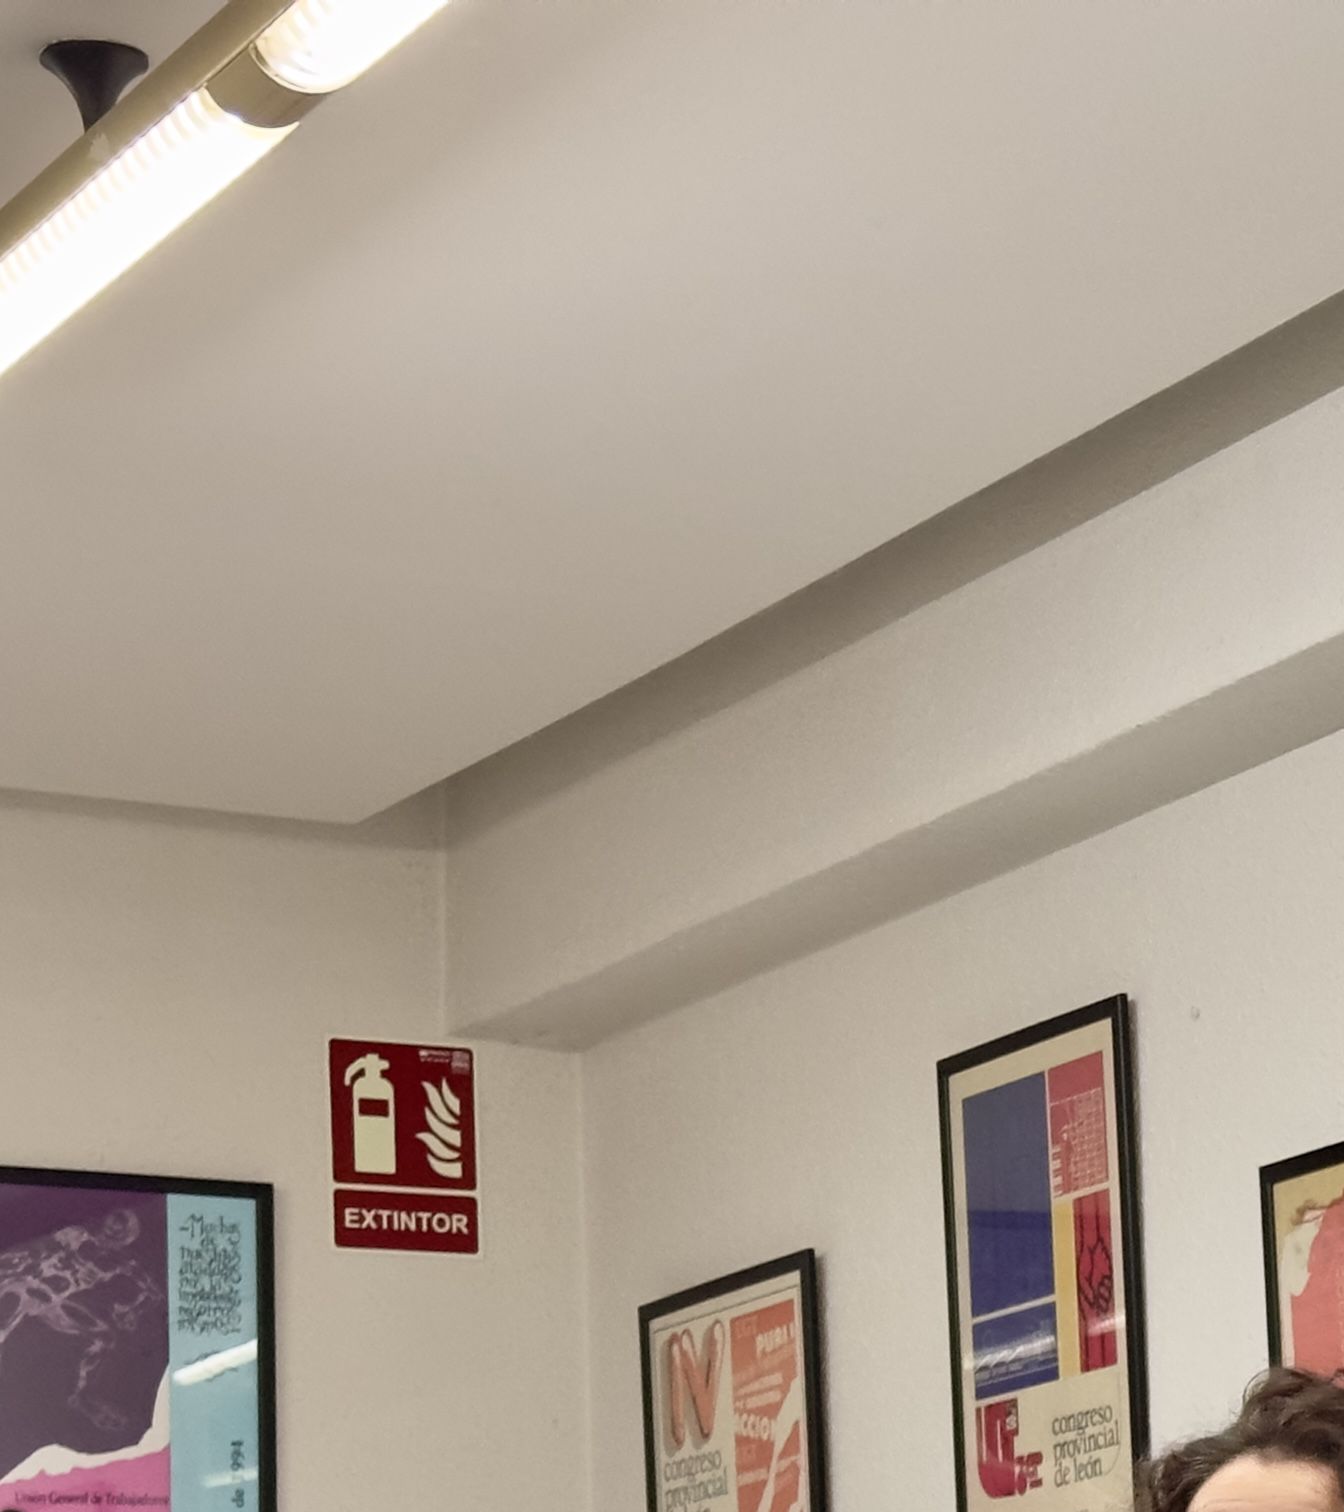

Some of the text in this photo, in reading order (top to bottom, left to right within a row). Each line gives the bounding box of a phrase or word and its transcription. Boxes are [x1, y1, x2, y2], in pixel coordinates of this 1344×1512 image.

[344, 1207, 469, 1235] EXTINTOR
[1052, 1404, 1113, 1436] congreso
[1053, 1419, 1120, 1466] provincial
[664, 1450, 722, 1485] congreso
[1053, 1456, 1102, 1488] de león
[231, 1487, 245, 1509] de
